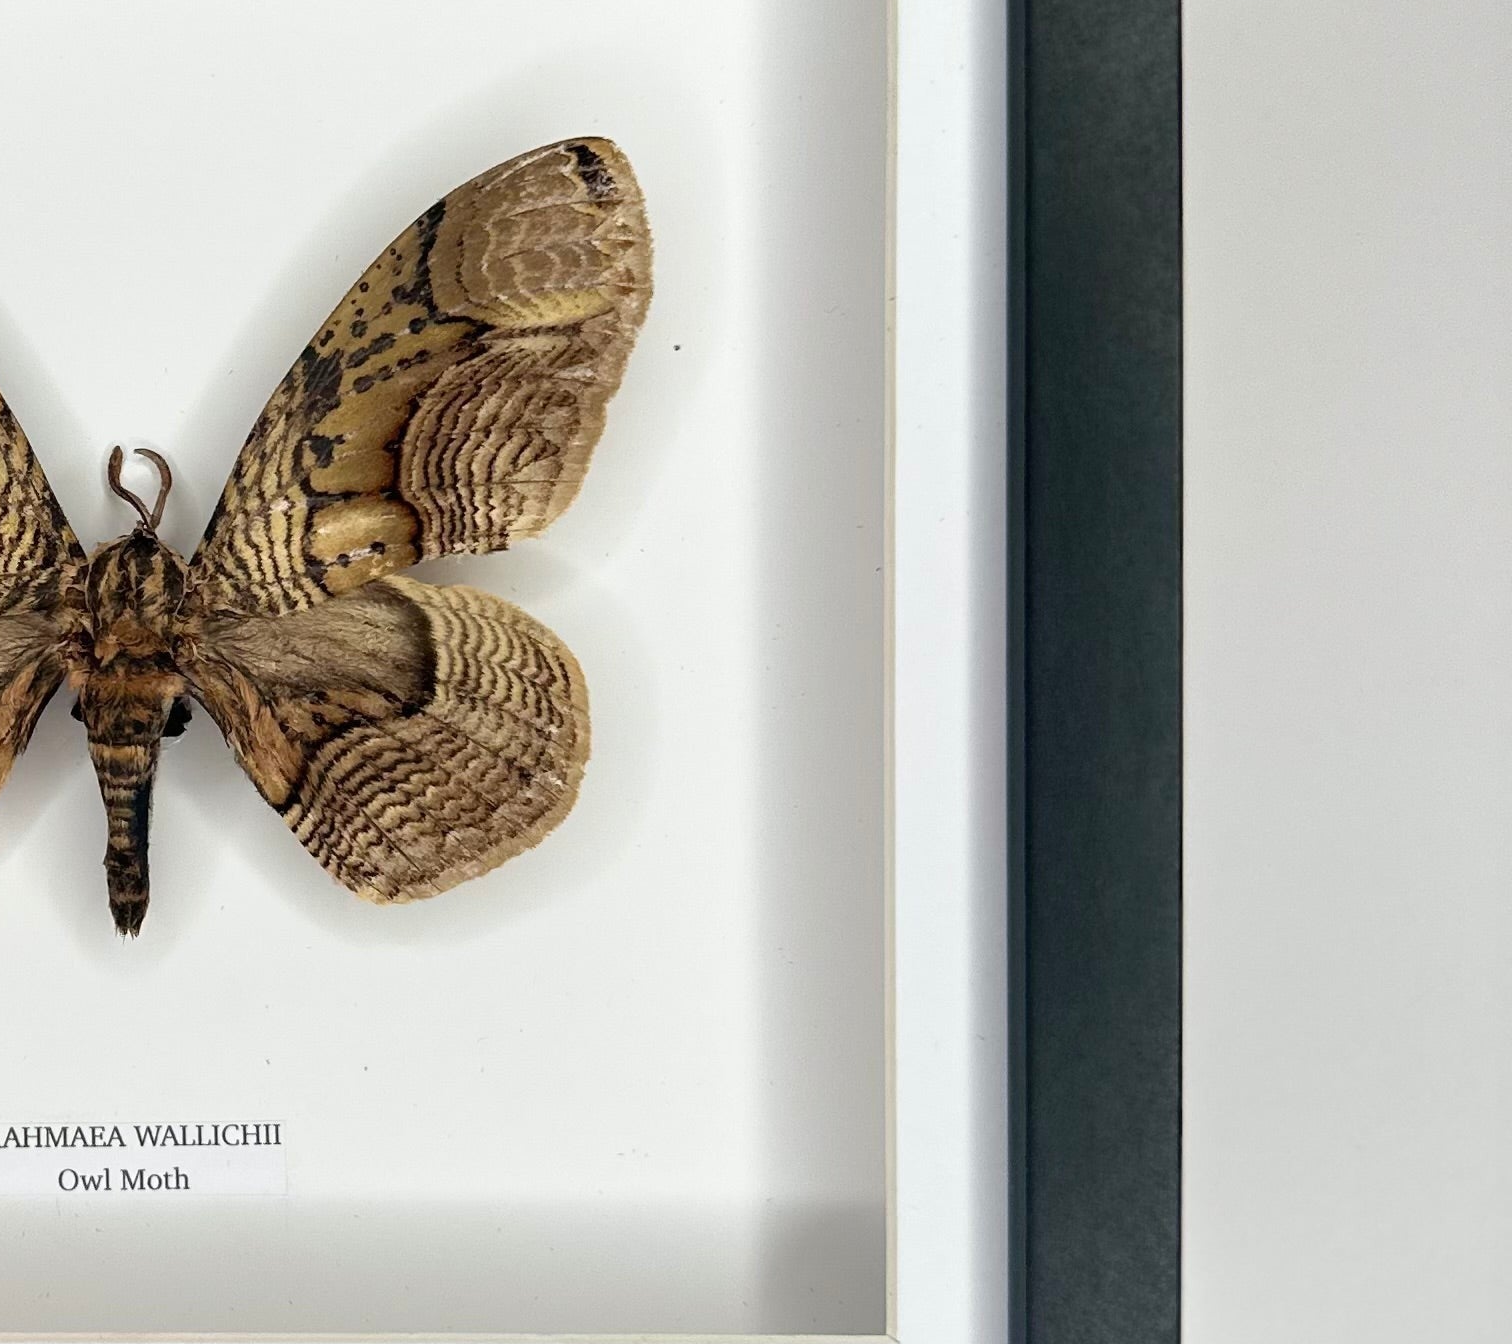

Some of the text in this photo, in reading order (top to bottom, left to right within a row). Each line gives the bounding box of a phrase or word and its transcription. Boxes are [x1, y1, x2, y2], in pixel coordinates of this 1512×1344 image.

[133, 1123, 282, 1147] WALLICHII
[57, 1166, 190, 1191] Owl Moth
